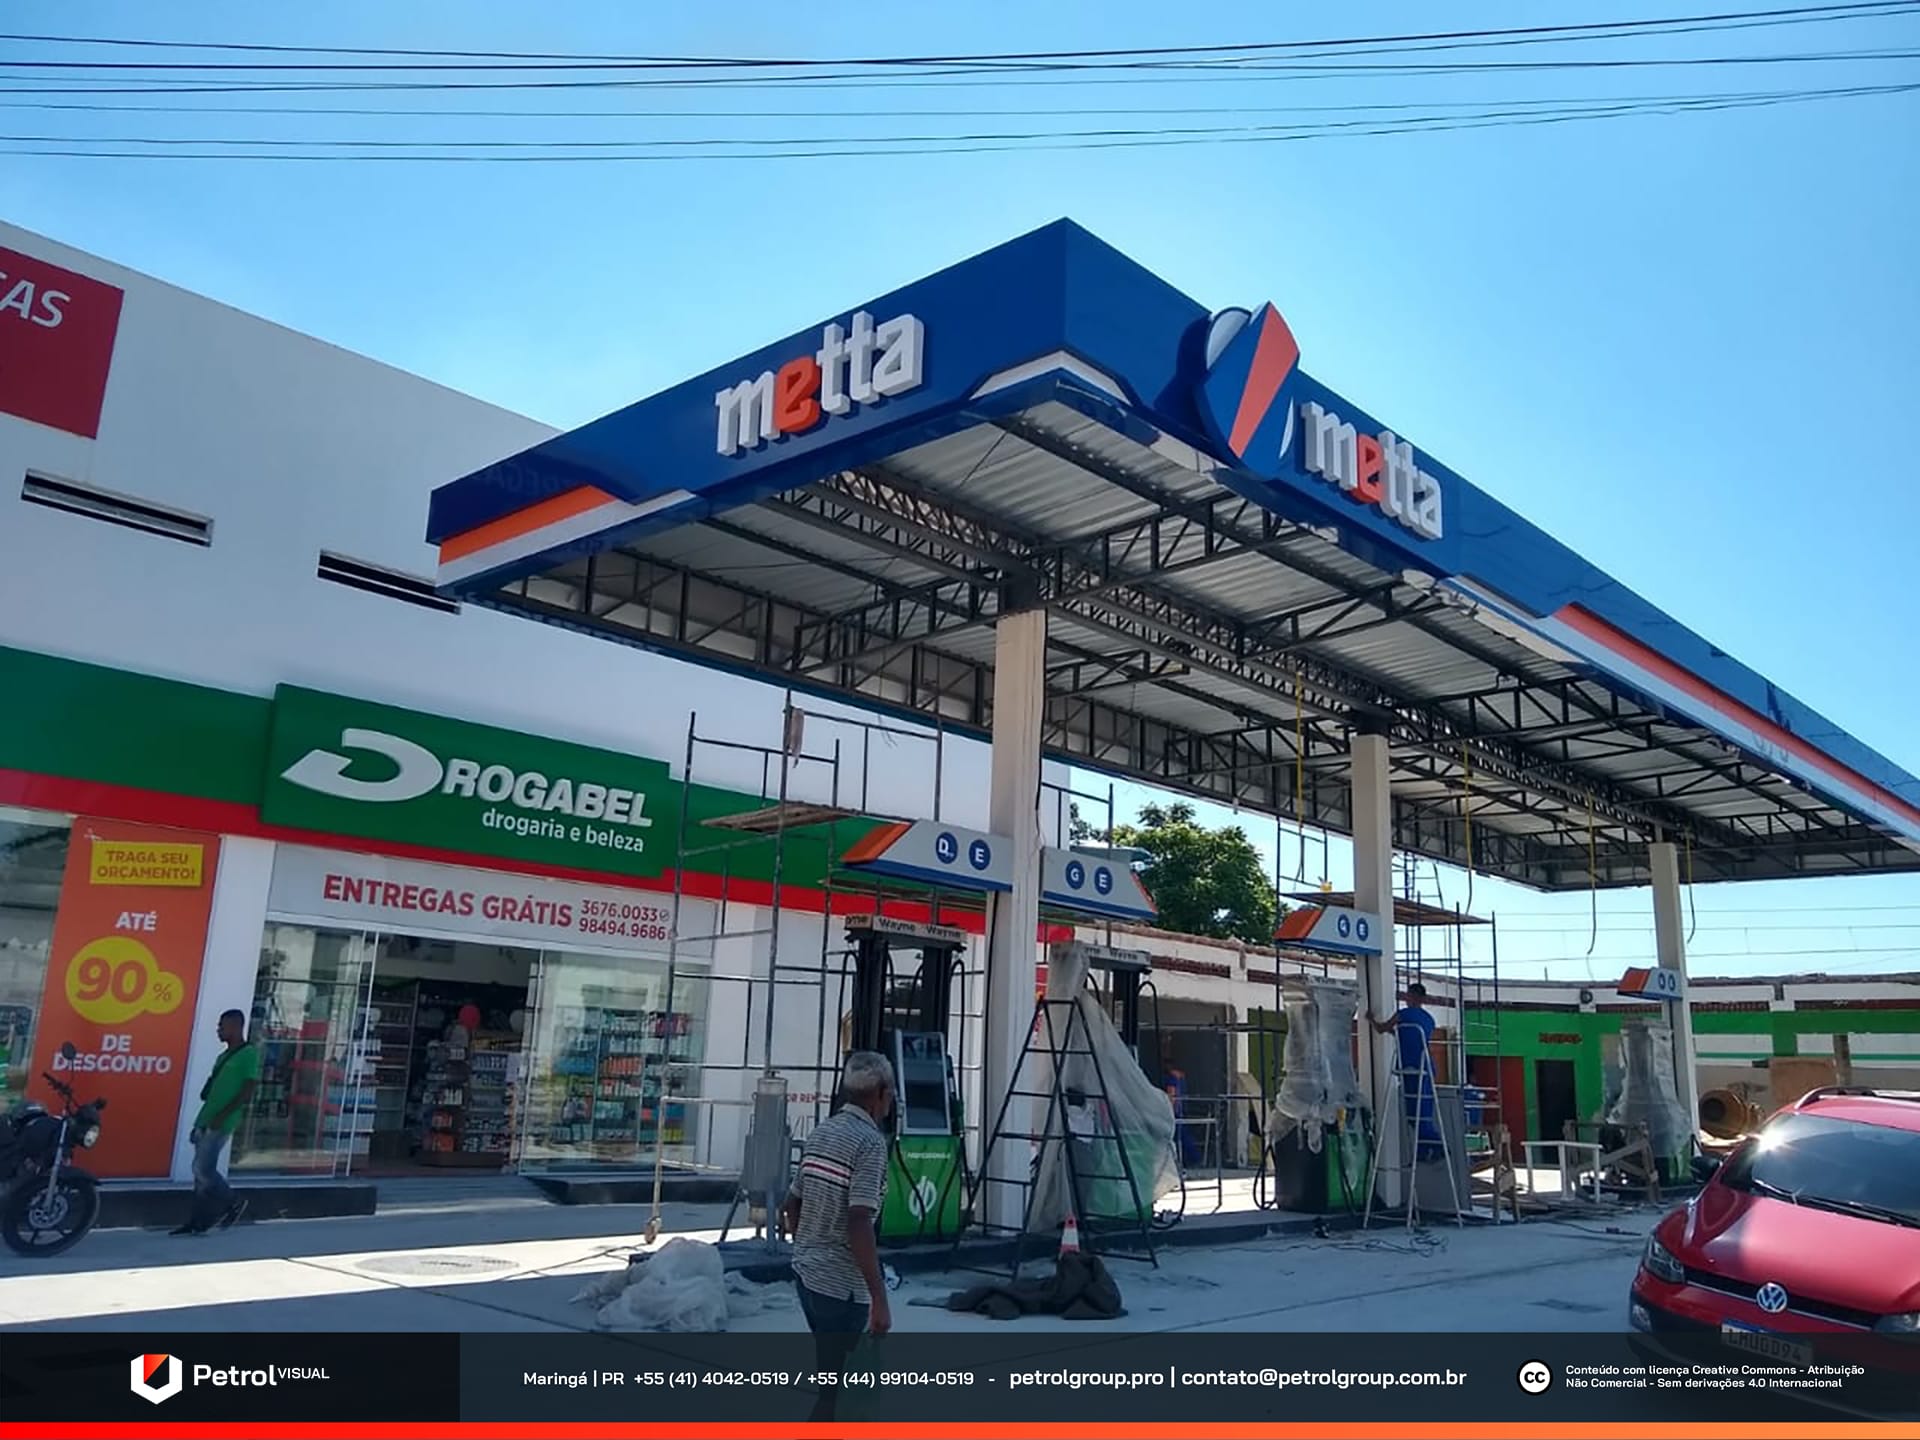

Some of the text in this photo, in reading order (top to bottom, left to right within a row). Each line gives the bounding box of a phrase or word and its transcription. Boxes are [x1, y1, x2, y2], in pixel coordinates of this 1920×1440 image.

[715, 310, 925, 456] metta
[1302, 400, 1443, 540] metta
[281, 728, 653, 827] DROGABEL
[482, 808, 644, 852] drogaria e beleza
[107, 850, 188, 864] TRAGA SEU
[97, 866, 195, 880] ORÇAMENTO!
[323, 874, 572, 927] ENTREGAS GRÁTIS
[581, 899, 658, 922] 3676.0033
[115, 910, 158, 931] ATÉ
[579, 917, 666, 940] 98494.9686
[878, 917, 916, 932] Wayne
[102, 1034, 132, 1052] DE
